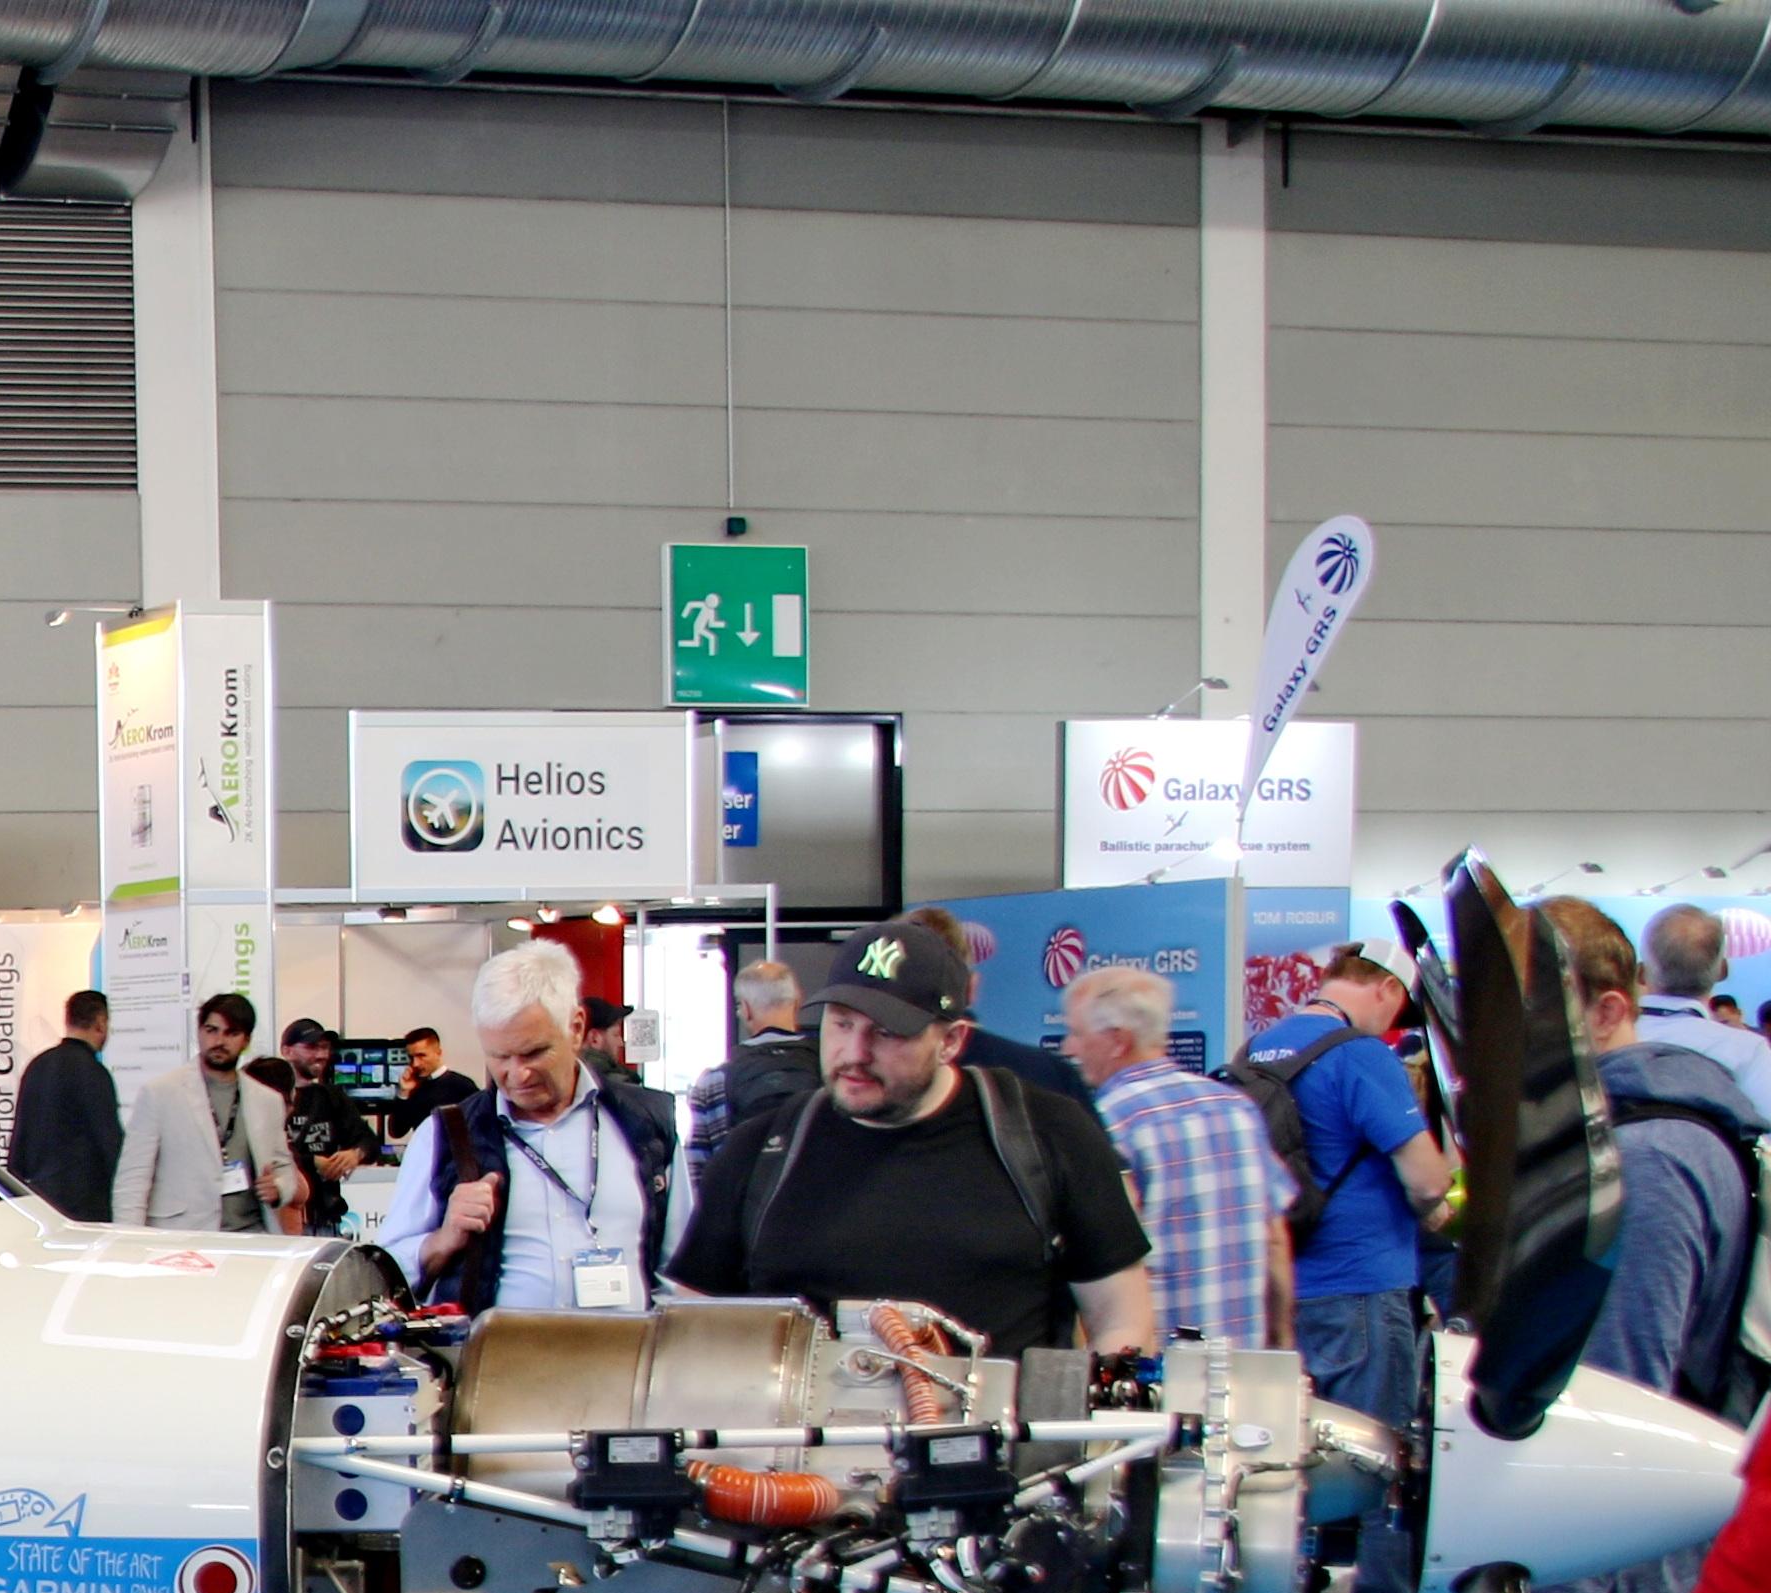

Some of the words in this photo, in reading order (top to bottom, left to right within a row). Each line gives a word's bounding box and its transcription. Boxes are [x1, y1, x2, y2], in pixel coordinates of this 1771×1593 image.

[1263, 660, 1307, 732] Galaxy
[1306, 606, 1338, 655] GRS
[496, 762, 605, 796] Helios
[1257, 778, 1312, 802] GRS
[495, 818, 644, 851] Avionics
[1100, 841, 1150, 852] Ballistic
[1267, 842, 1310, 857] system
[1155, 949, 1198, 974] GRS
[7, 1542, 63, 1573] STATE
[67, 1545, 93, 1575] OF
[95, 1549, 126, 1577] THE
[128, 1552, 163, 1581] ART
